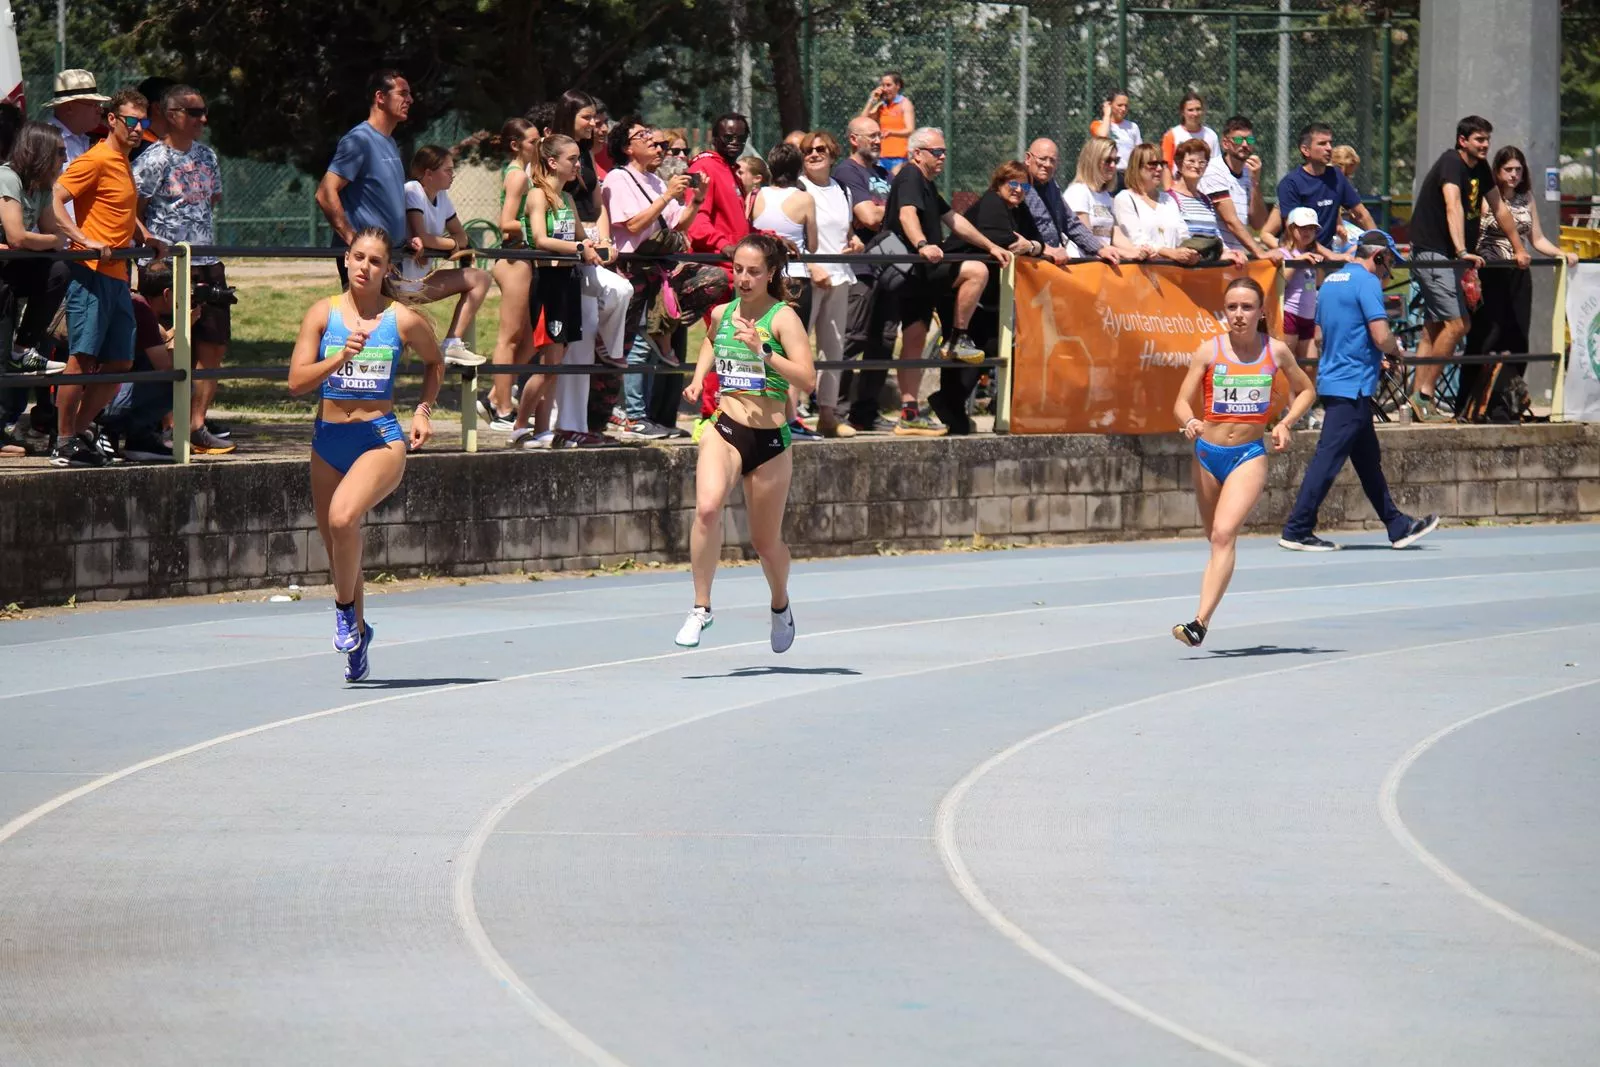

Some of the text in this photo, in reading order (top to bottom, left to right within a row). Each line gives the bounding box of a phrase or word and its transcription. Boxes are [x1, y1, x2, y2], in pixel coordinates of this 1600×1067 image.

[1103, 306, 1195, 338] Ayuntamiento
[1196, 311, 1217, 333] de
[719, 359, 733, 375] 24
[1223, 388, 1238, 402] 14
